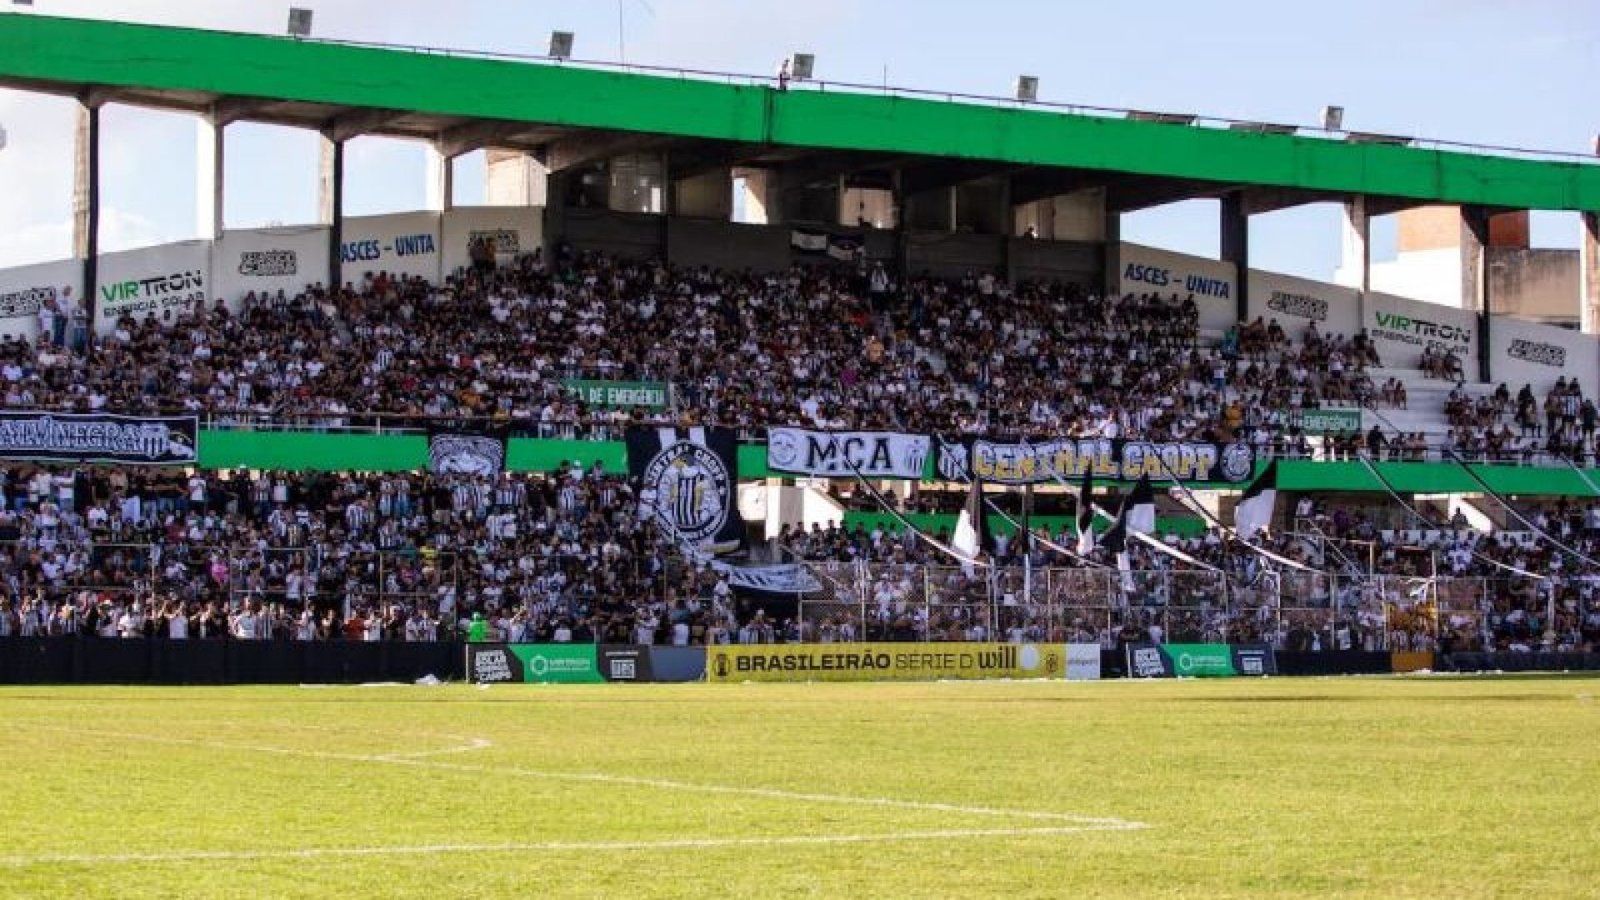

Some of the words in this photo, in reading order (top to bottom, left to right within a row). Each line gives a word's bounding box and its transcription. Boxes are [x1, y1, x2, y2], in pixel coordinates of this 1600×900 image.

[341, 240, 380, 263] ASCES
[396, 234, 434, 256] UNITA
[101, 269, 203, 302] VIRTRON
[1124, 263, 1168, 286] ASCES
[1186, 275, 1230, 298] UNITA
[1375, 311, 1470, 343] VIRTRON
[590, 387, 602, 402] DE
[805, 434, 893, 471] MCA
[736, 649, 891, 672] BRASILEIRÃO
[959, 653, 972, 669] D
[977, 646, 1016, 669] will
